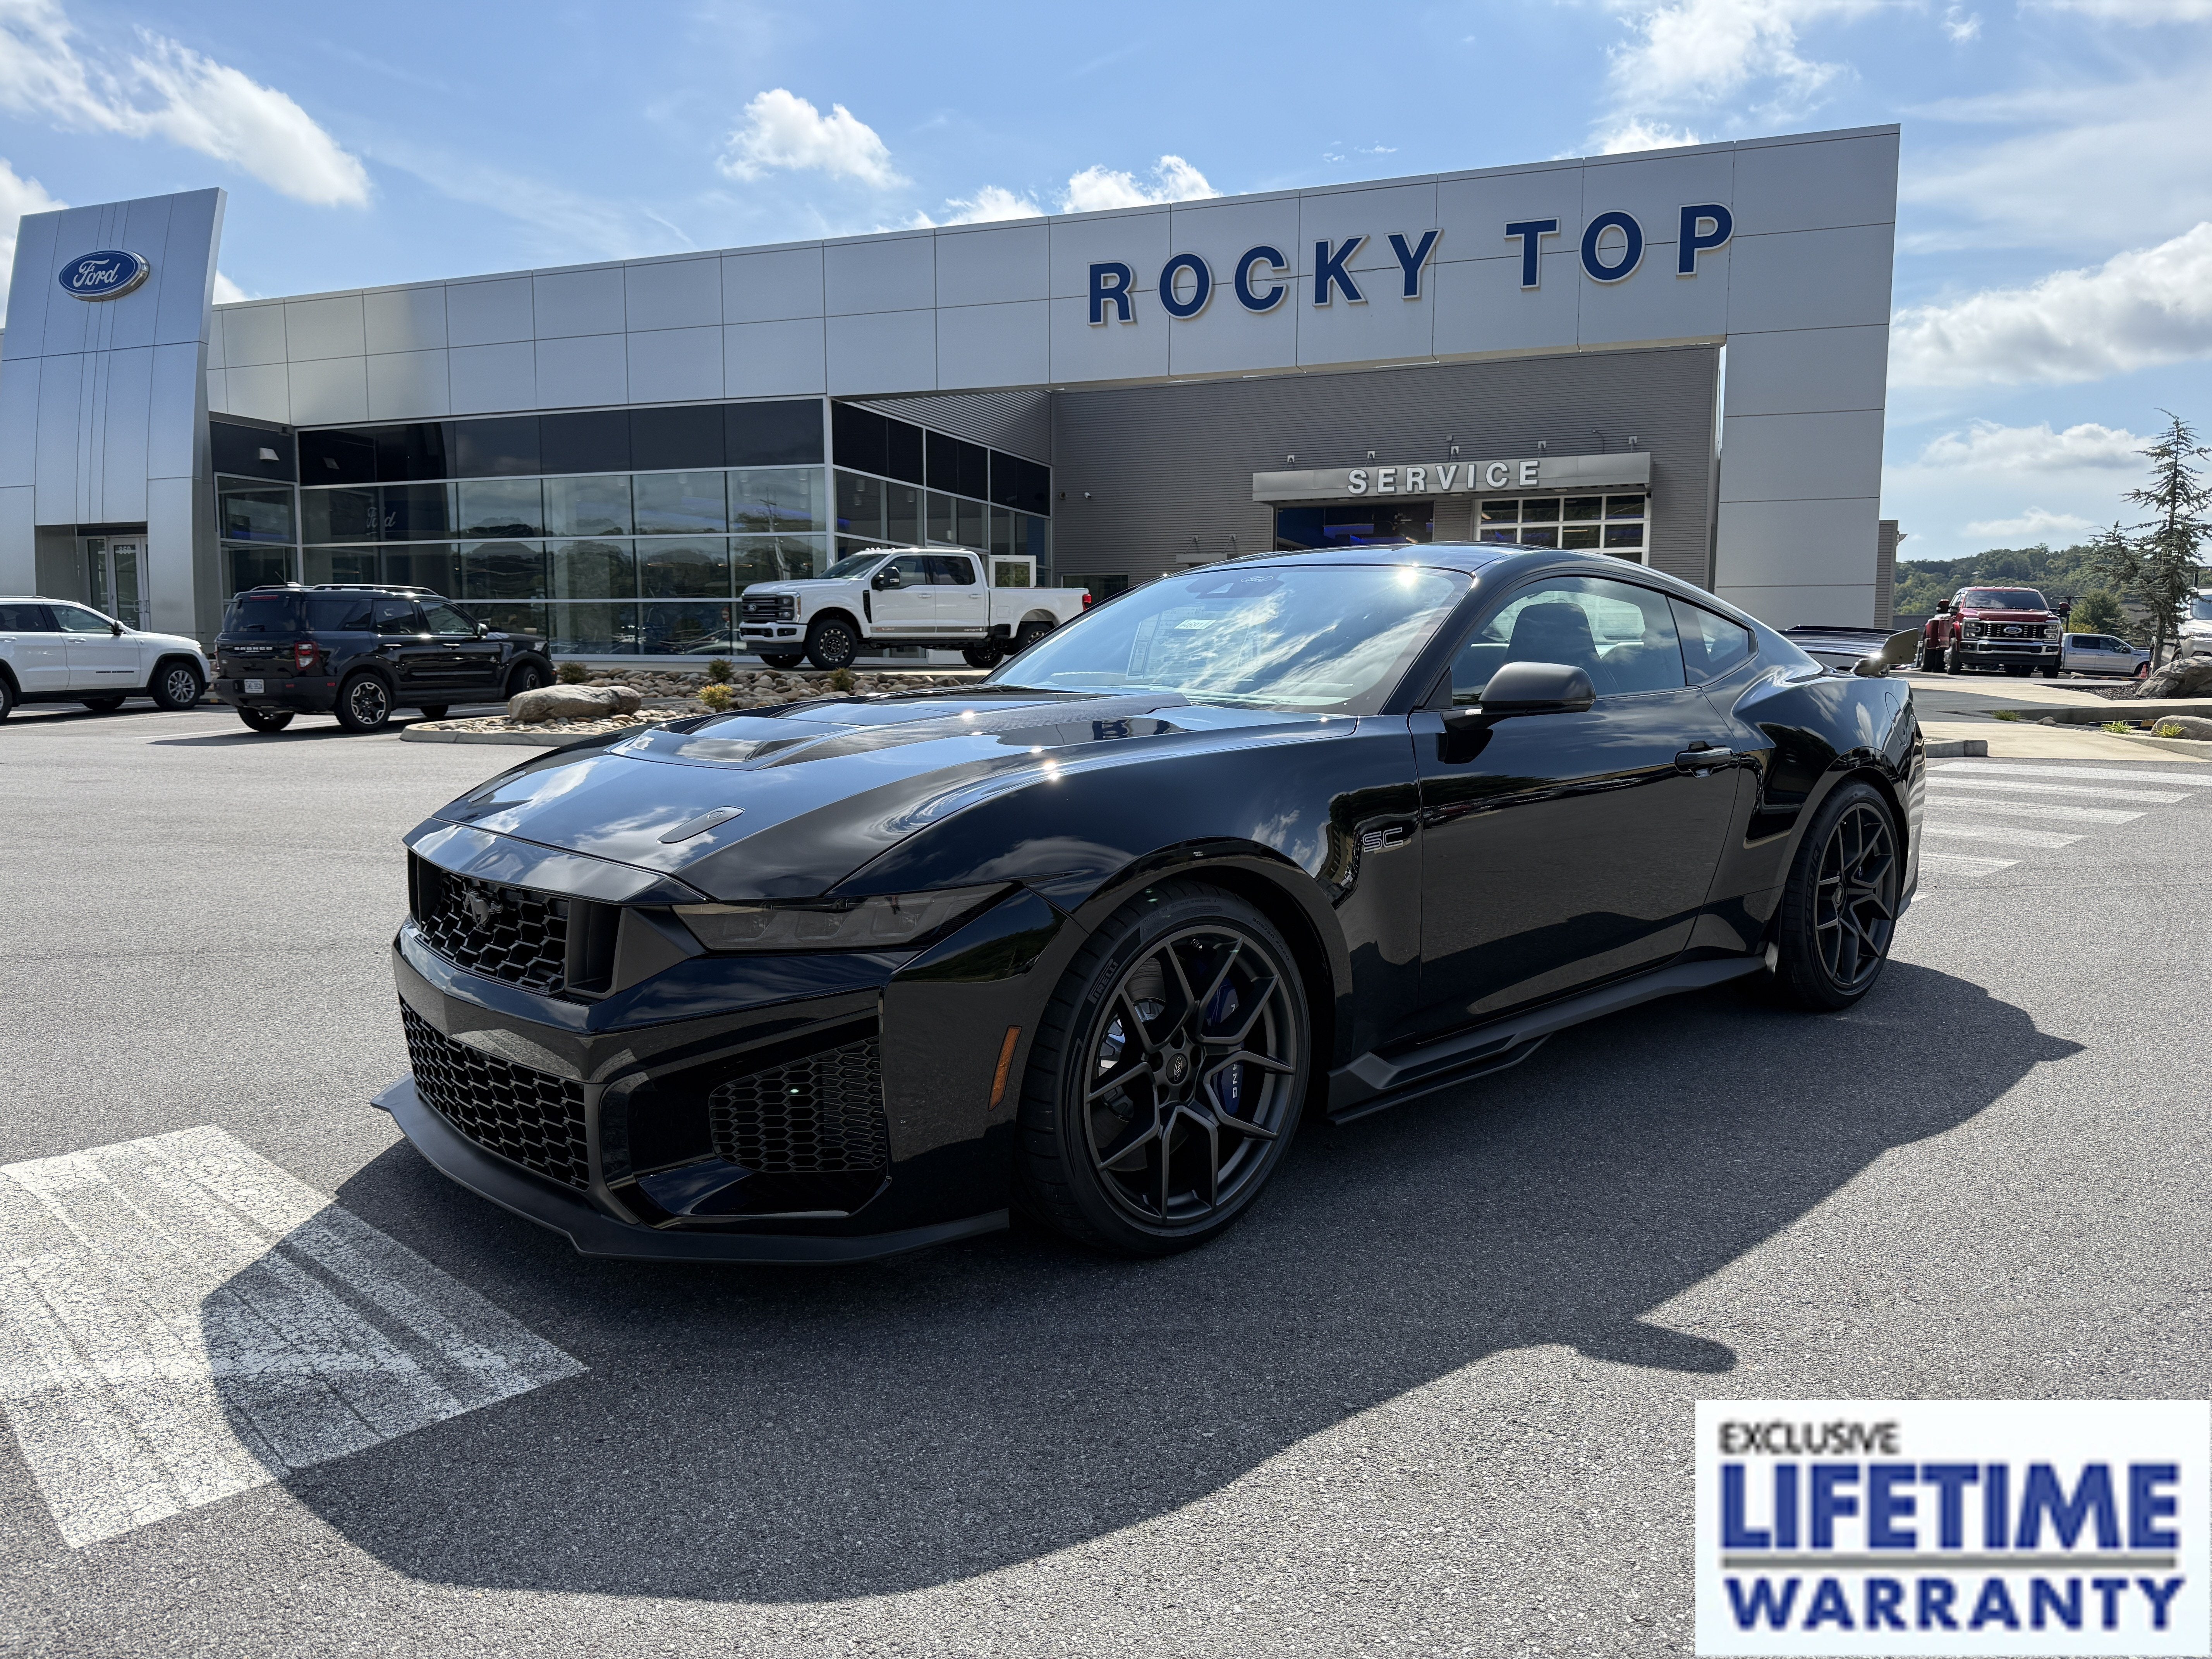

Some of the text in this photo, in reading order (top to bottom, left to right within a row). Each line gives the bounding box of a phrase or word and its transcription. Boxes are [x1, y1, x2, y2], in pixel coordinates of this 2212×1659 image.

[73, 259, 121, 287] Ford
[1087, 201, 1735, 326] ROCKY TOP
[1347, 460, 1540, 495] SERVICE
[366, 507, 396, 528] Fod
[1363, 827, 1403, 853] SC
[1087, 958, 1119, 1005] PIRELLI
